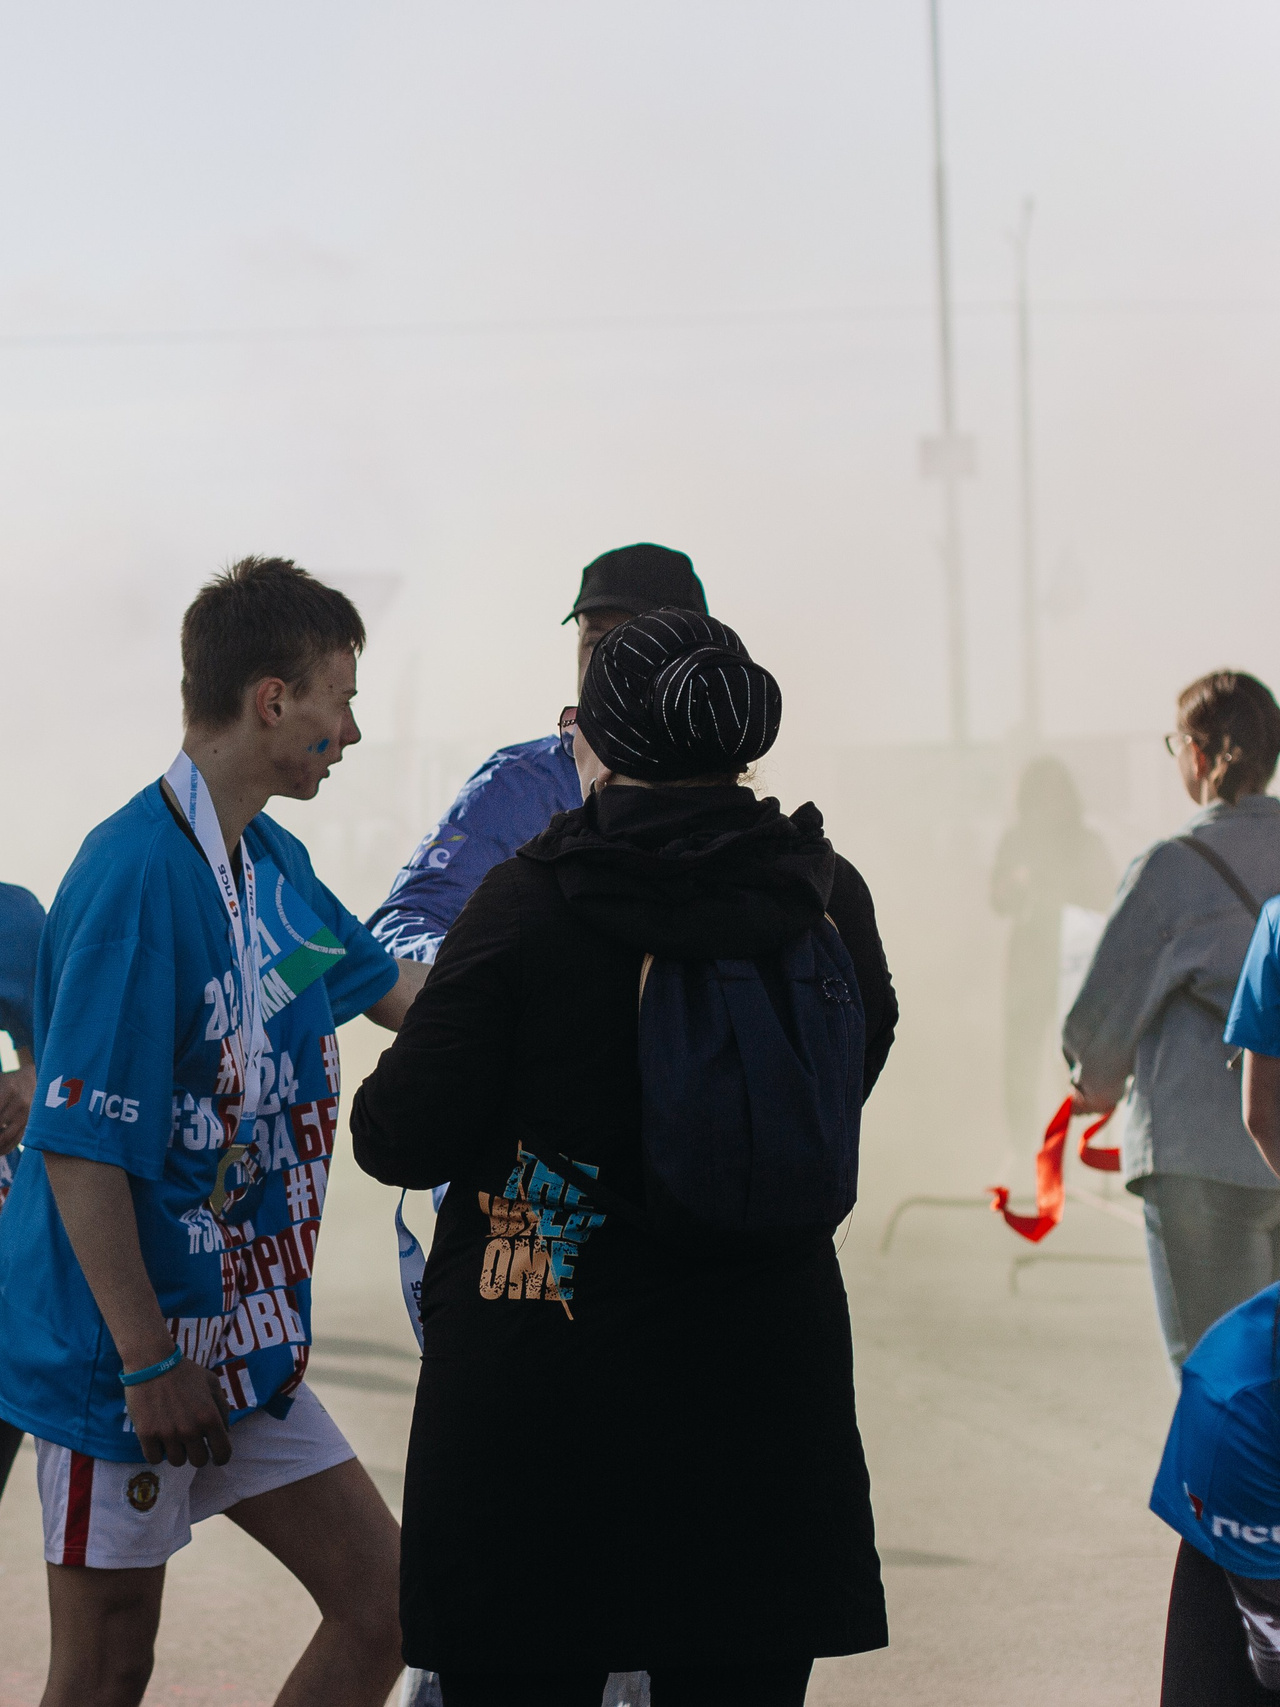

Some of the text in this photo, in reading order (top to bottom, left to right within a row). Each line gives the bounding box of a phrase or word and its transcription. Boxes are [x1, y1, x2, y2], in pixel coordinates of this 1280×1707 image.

[218, 864, 232, 897] ПСБ
[88, 1090, 140, 1123] ПСБ
[478, 1237, 579, 1300] ONE
